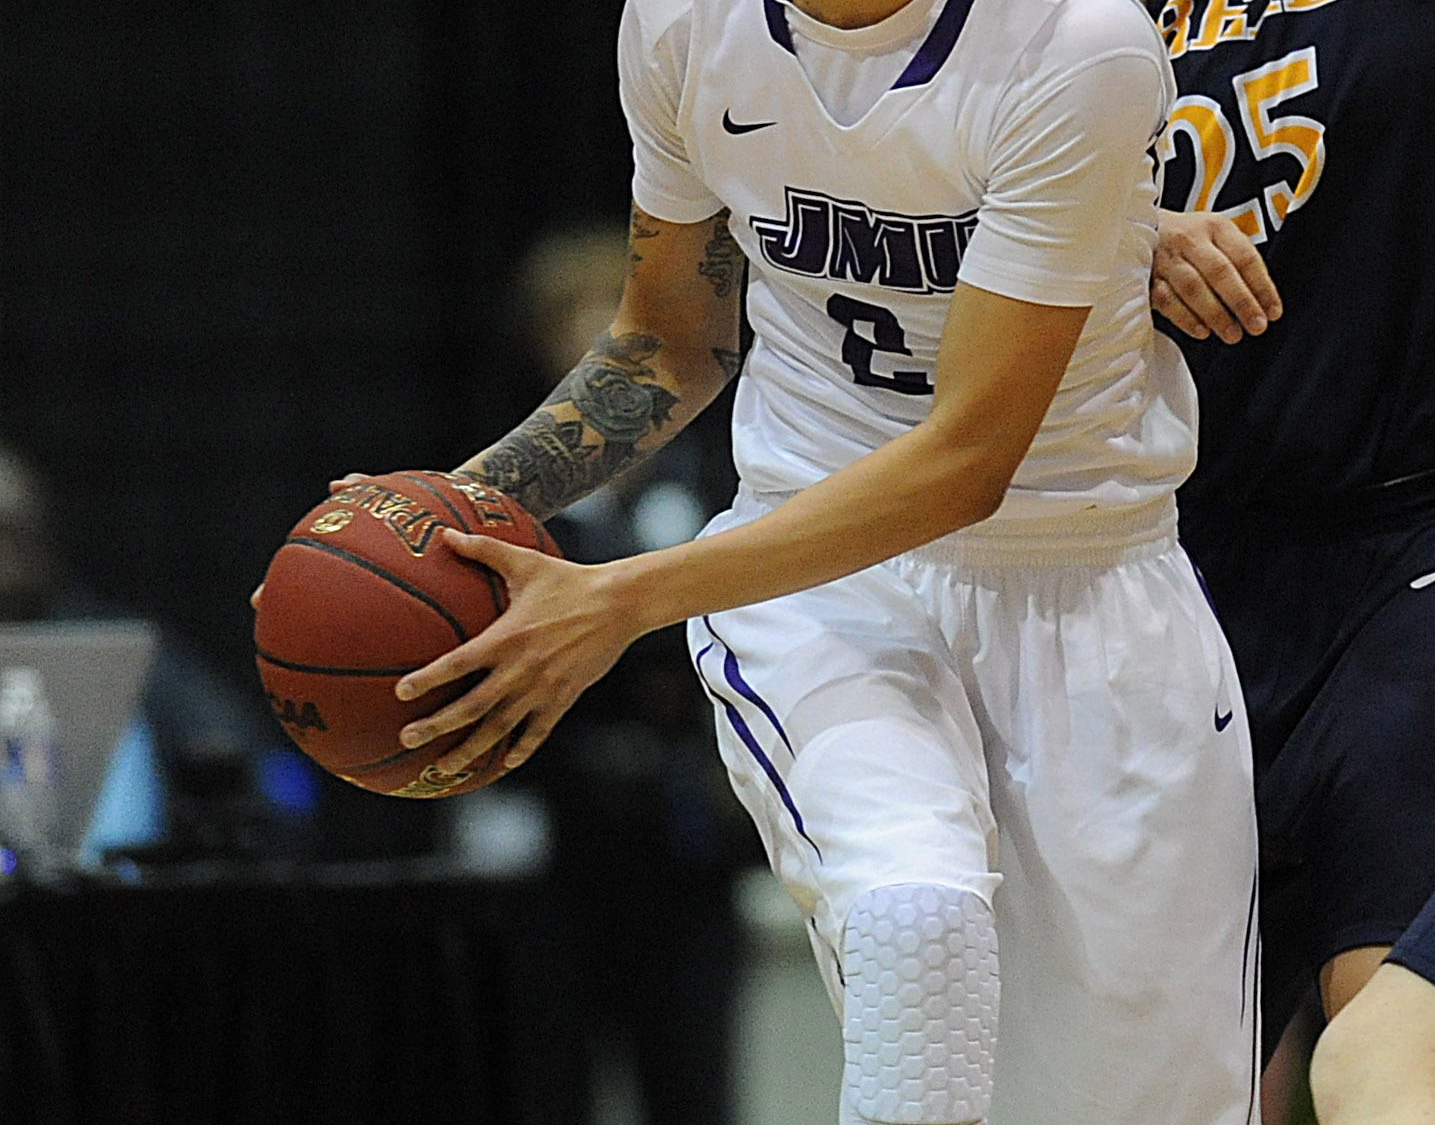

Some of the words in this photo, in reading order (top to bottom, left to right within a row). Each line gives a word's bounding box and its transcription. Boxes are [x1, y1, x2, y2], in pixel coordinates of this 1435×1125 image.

[1163, 46, 1326, 245] 25
[750, 185, 981, 295] JMU
[826, 292, 935, 396] 2
